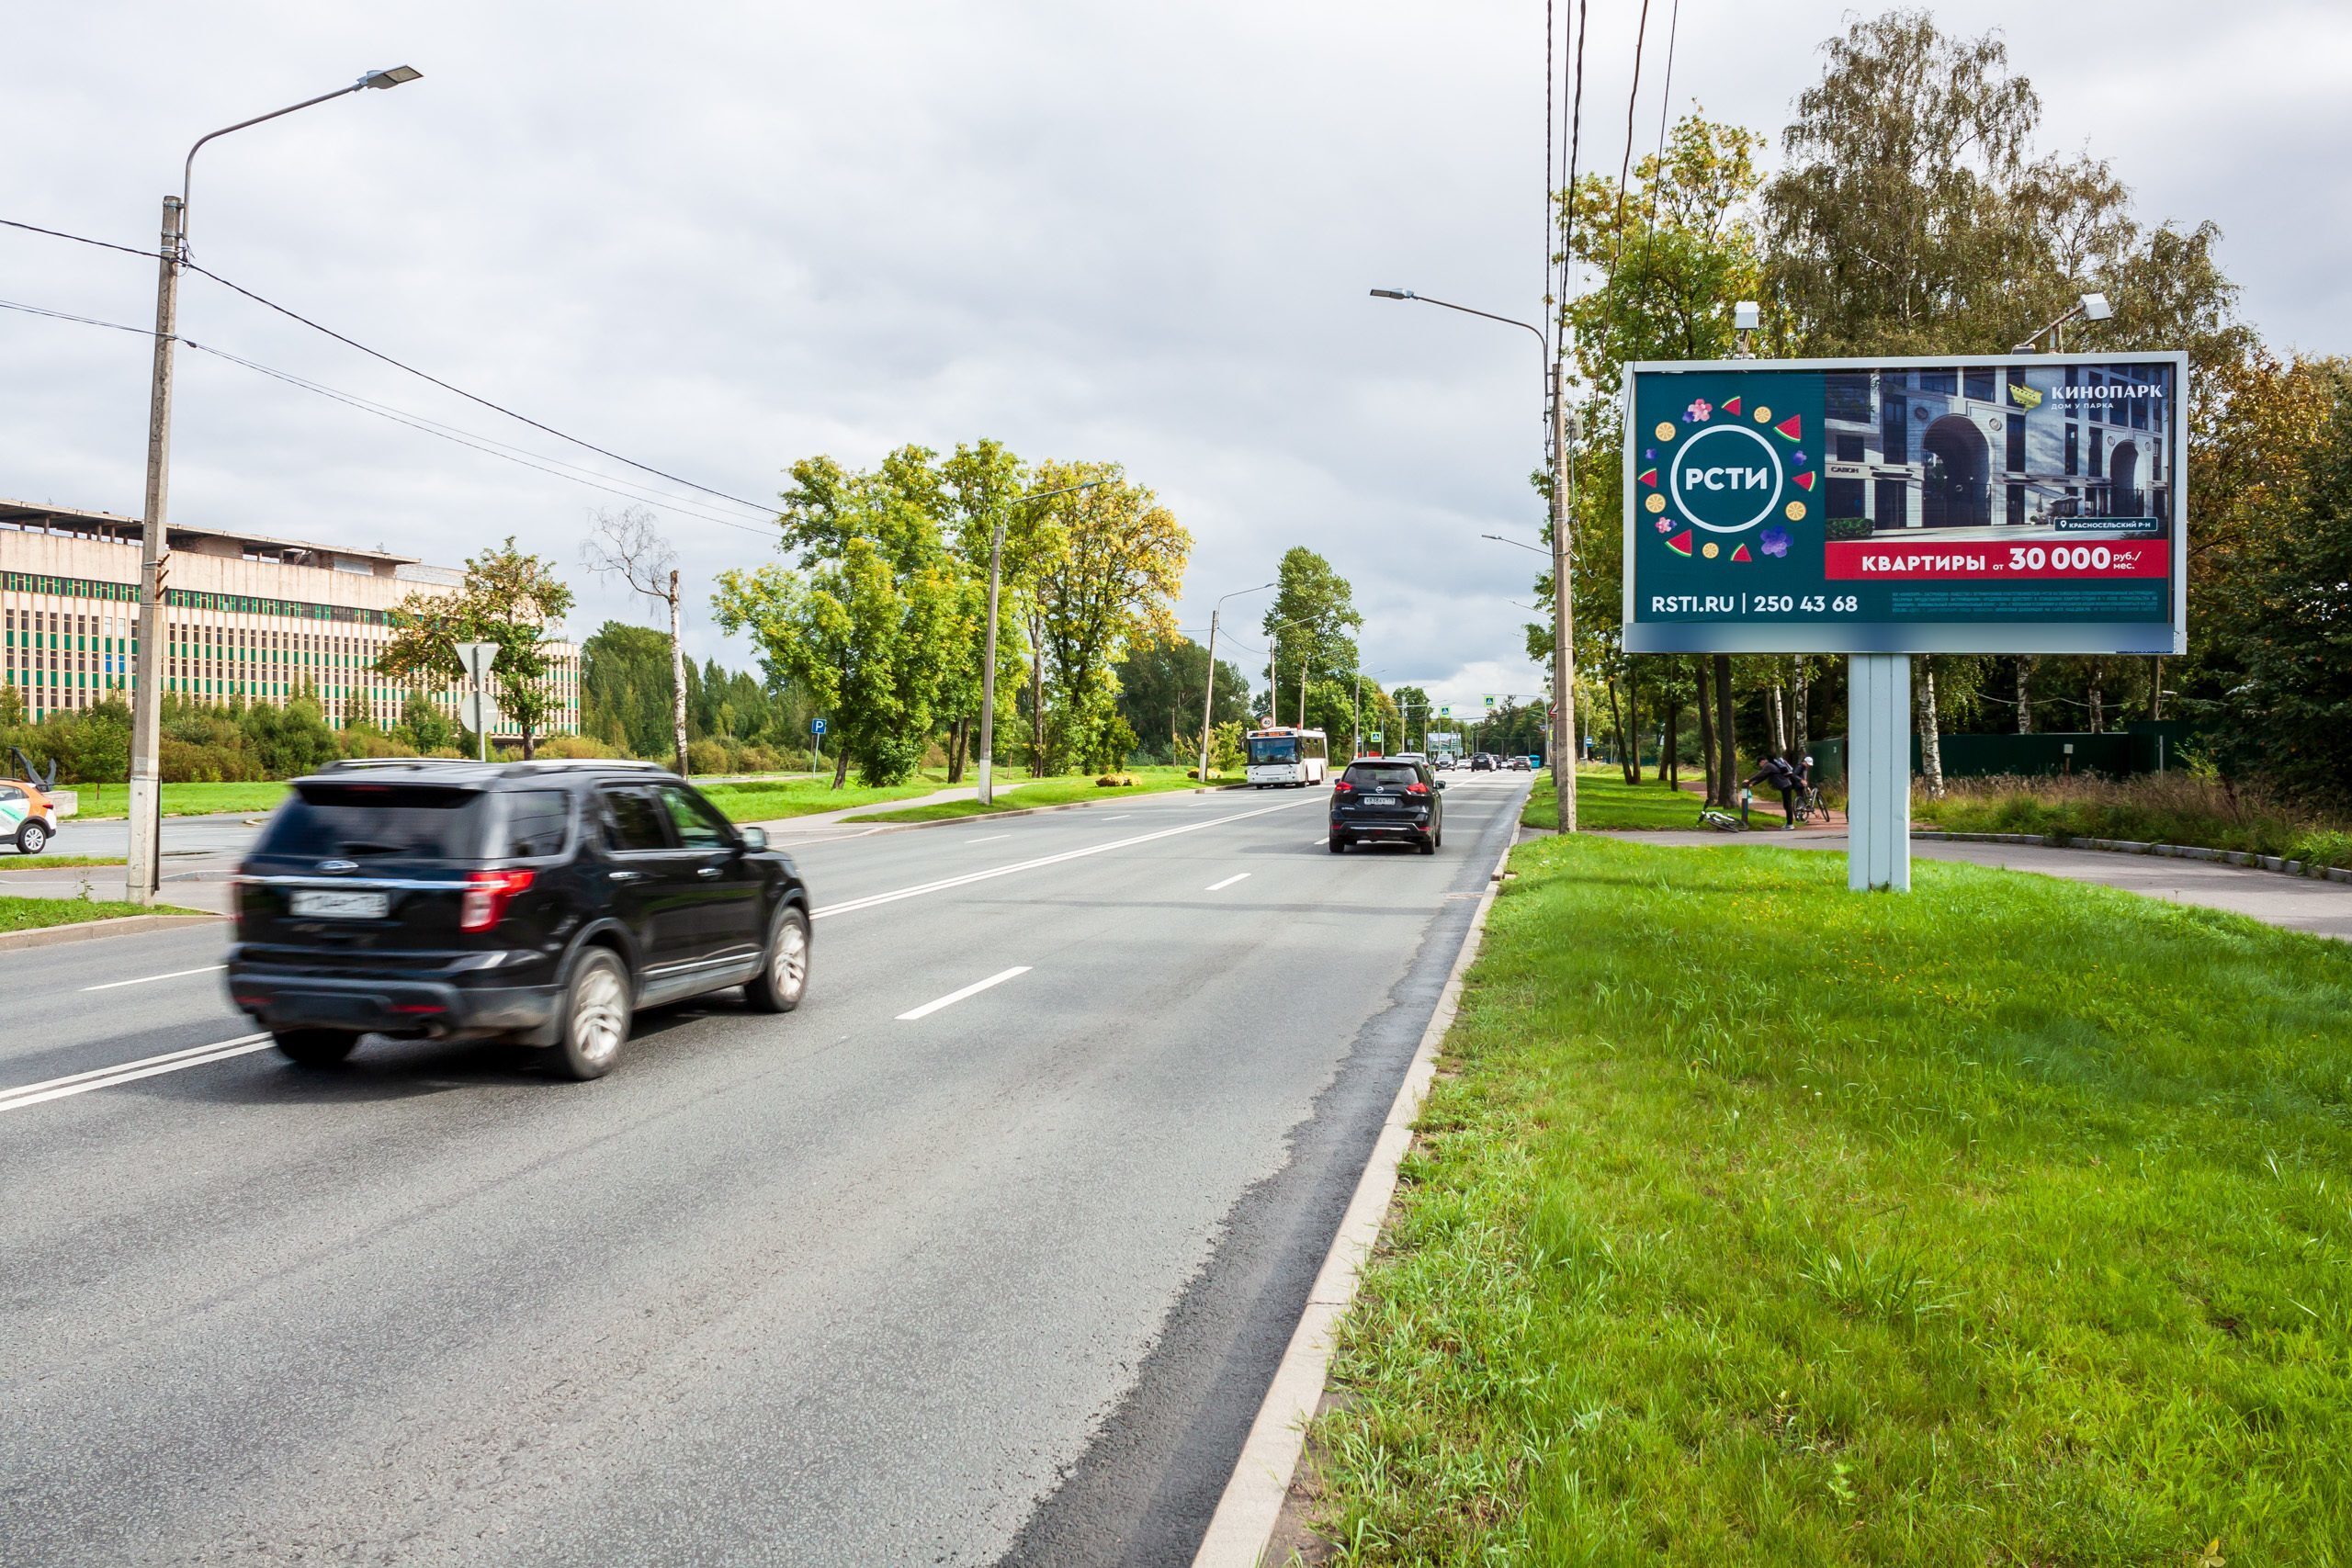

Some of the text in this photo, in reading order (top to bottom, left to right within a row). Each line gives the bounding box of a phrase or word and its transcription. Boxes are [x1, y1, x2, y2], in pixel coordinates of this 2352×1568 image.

[2052, 385, 2163, 400] КИНОПАРК
[2051, 402, 2072, 411] ДОМ
[1685, 467, 1768, 491] РСТИ
[2068, 520, 2137, 529] КРАСНОСЕЛЬСКИЙ
[1861, 555, 1985, 571] КВАРТИРЫ
[2008, 547, 2046, 570] 30
[2051, 547, 2111, 570] 000
[1652, 595, 1735, 613] RSTI.RU
[1754, 595, 1793, 613] 250
[1799, 595, 1826, 613] 43
[1832, 595, 1858, 613] 68
